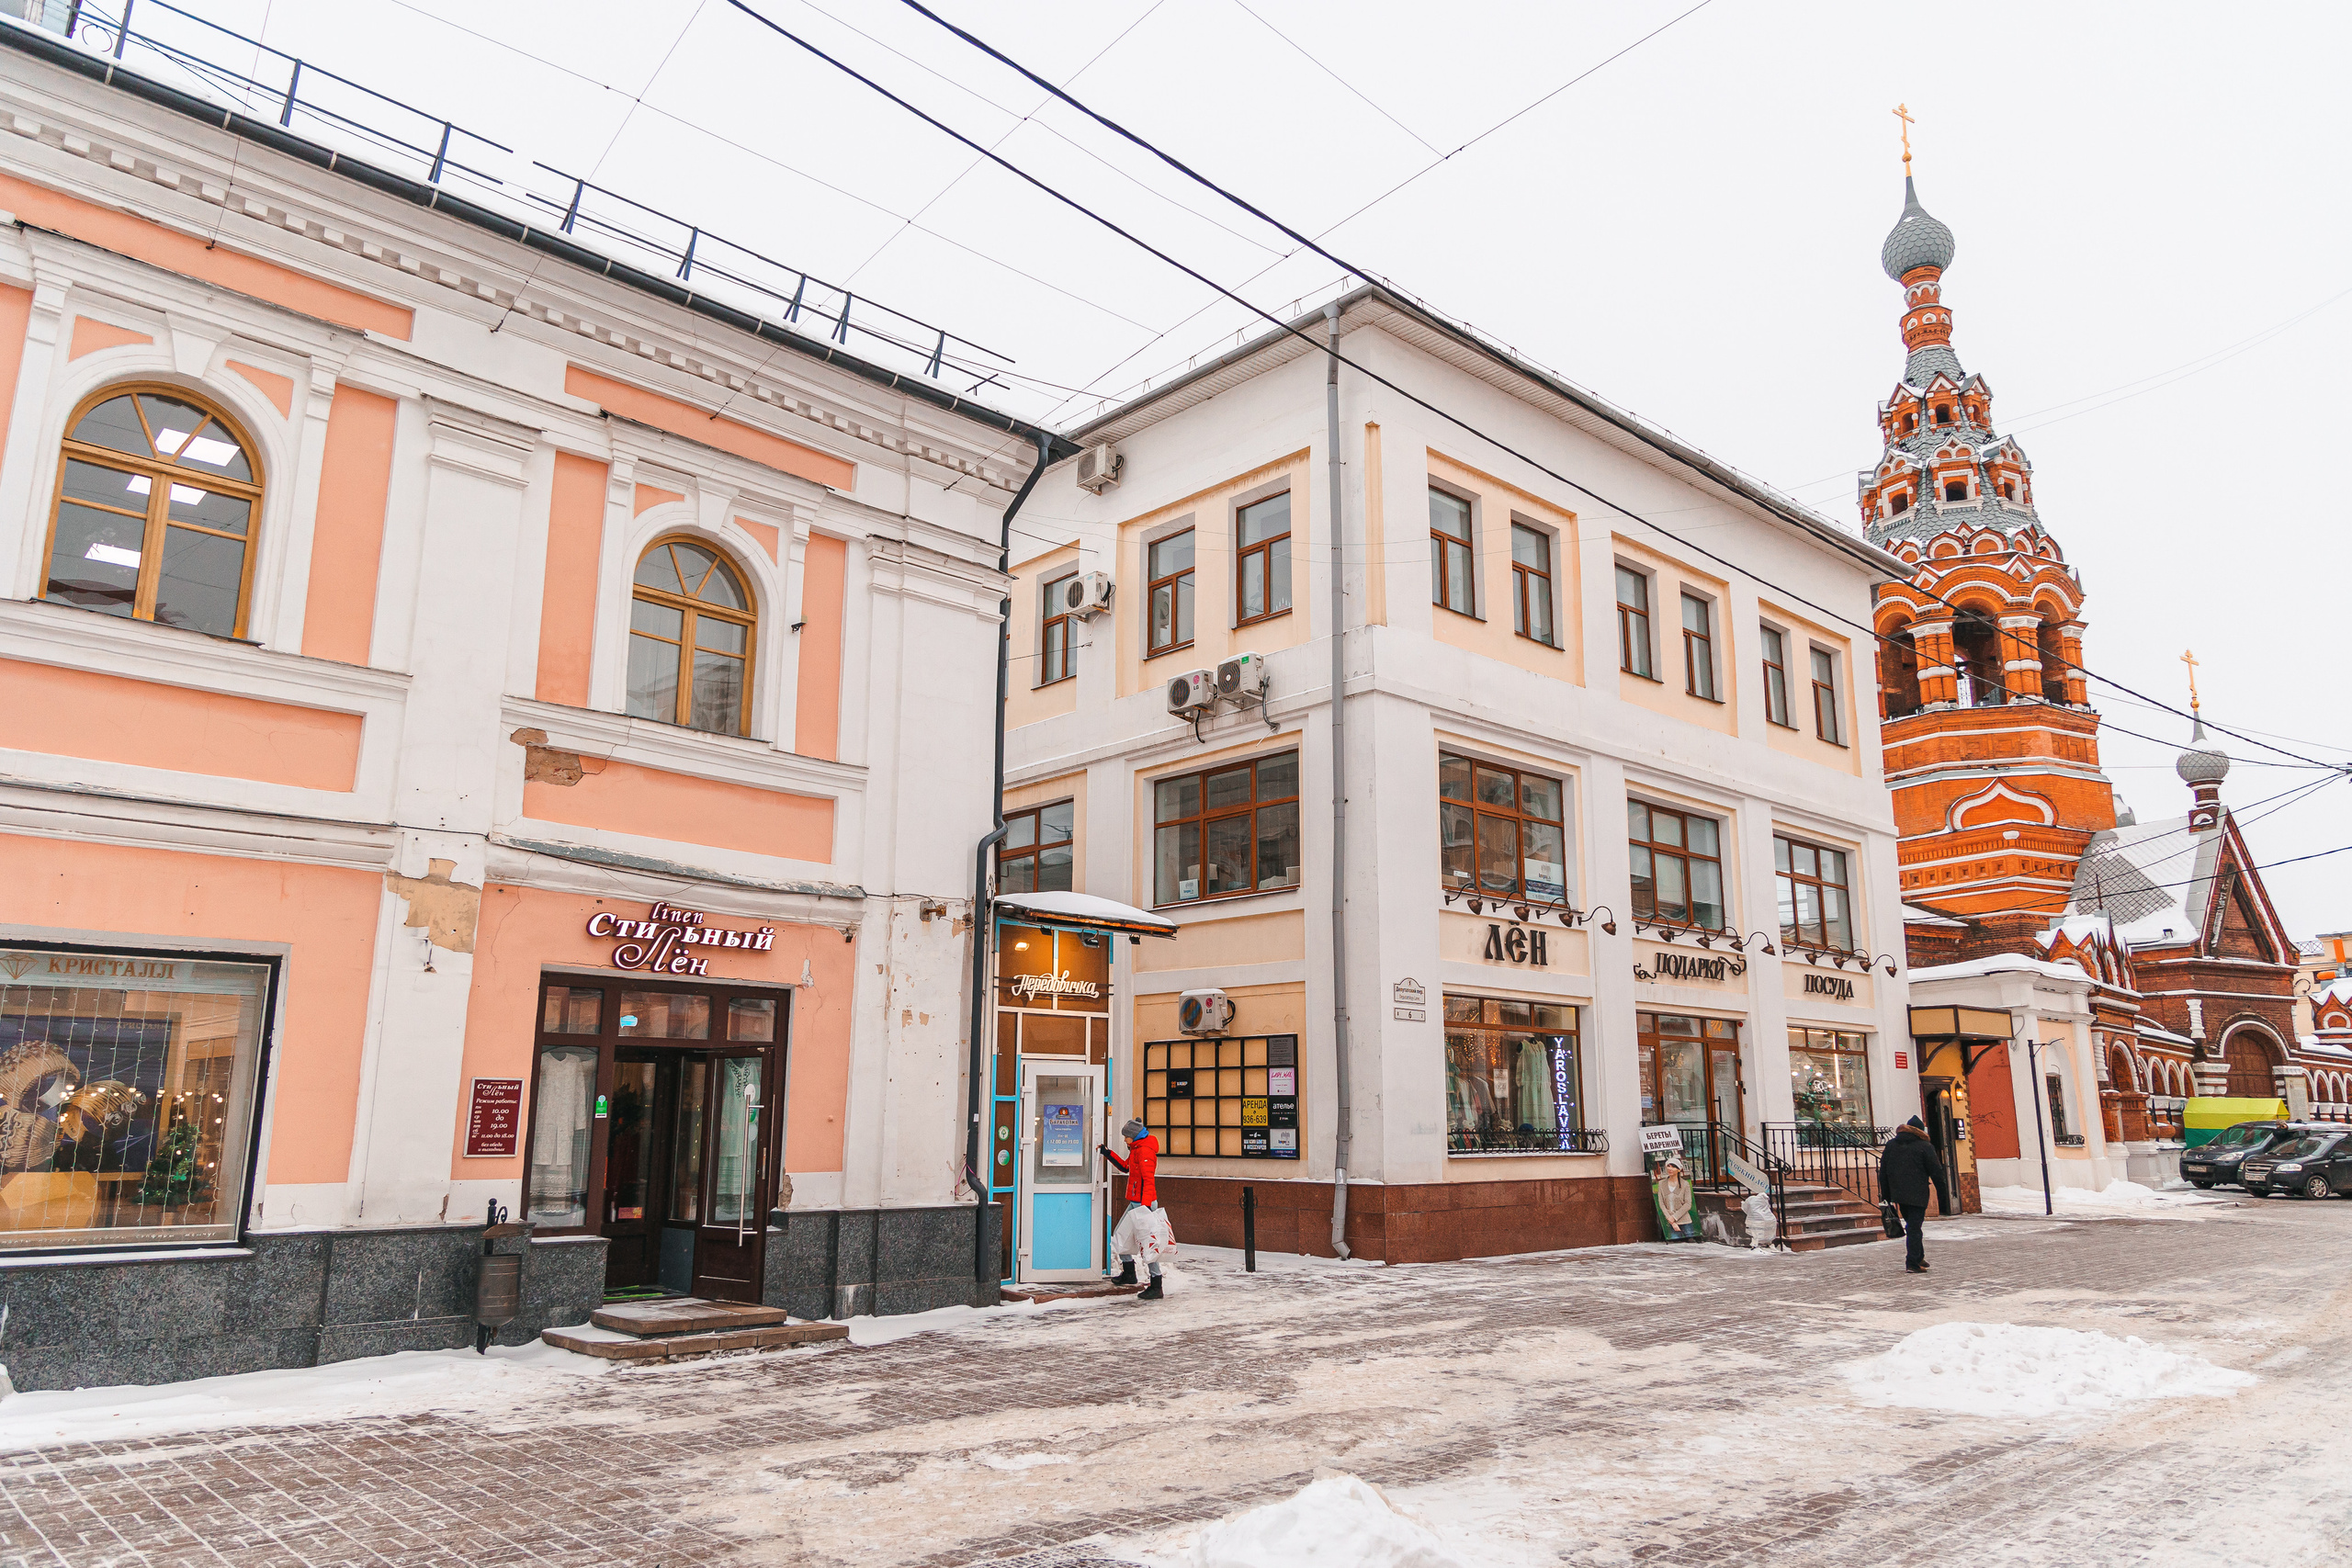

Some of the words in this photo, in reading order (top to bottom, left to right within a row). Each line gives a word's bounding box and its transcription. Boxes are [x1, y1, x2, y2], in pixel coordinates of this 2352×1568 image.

[651, 901, 704, 924] linen
[615, 927, 708, 976] Лён
[48, 956, 175, 979] КРИСТАЛЛ
[1655, 952, 1725, 981] ПОДАРКИ
[1804, 974, 1854, 1000] ПОСУДА
[1242, 1100, 1267, 1110] АРЕНДА
[1242, 1114, 1267, 1124] 936-639
[1644, 1143, 1649, 1151] И
[1649, 1139, 1680, 1150] ВАРЕЖКИ
[1645, 1131, 1672, 1140] БЕРЕТЫ
